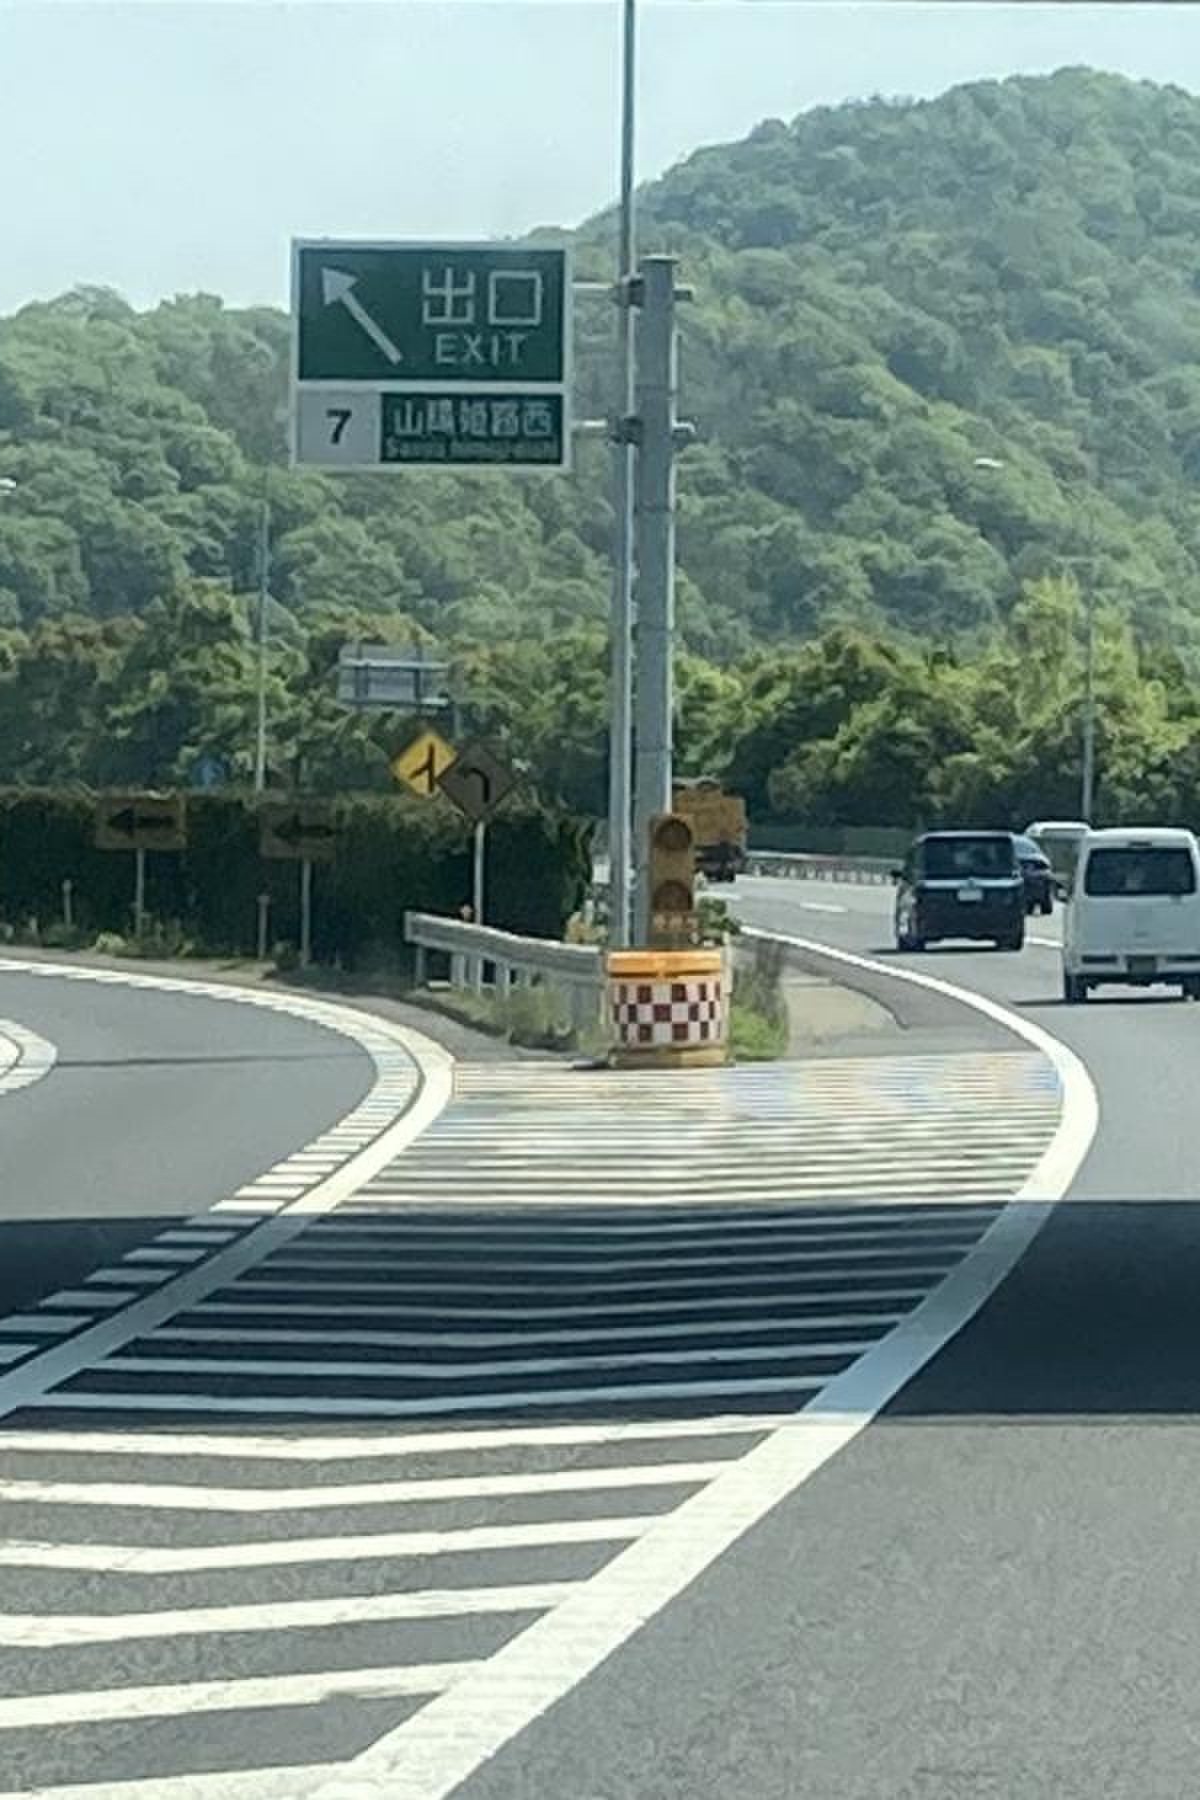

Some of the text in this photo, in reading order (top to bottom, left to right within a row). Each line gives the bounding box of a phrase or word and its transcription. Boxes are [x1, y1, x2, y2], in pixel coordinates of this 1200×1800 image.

[422, 267, 542, 325] 出口
[436, 333, 527, 366] EXIT
[326, 409, 353, 446] 7
